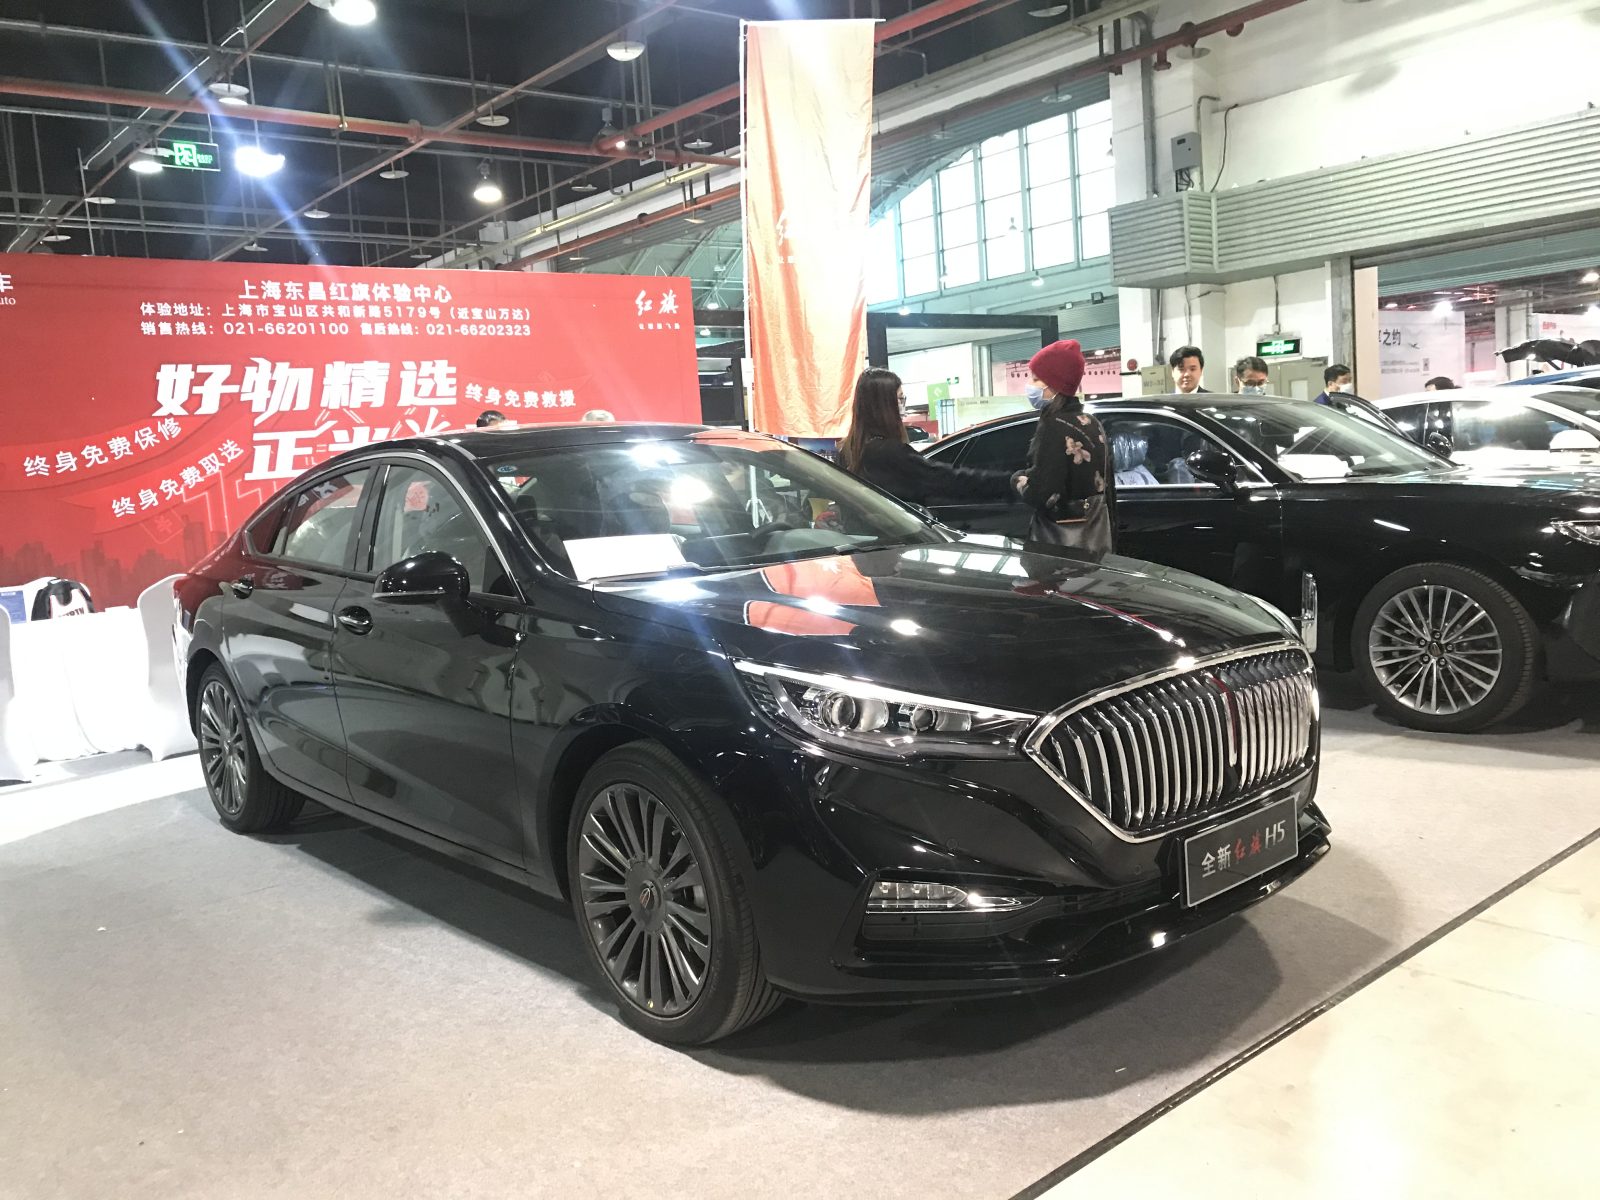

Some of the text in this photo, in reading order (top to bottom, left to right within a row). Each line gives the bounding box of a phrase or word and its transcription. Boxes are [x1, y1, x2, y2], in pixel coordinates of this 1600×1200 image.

[238, 279, 452, 303] 上海东昌红旗体验中心
[1378, 327, 1402, 346] 之约
[151, 357, 457, 427] 好物精选
[464, 382, 577, 409] 终身免费救援
[23, 416, 182, 478] 终身免费保修
[111, 439, 245, 519] 终身免费取送
